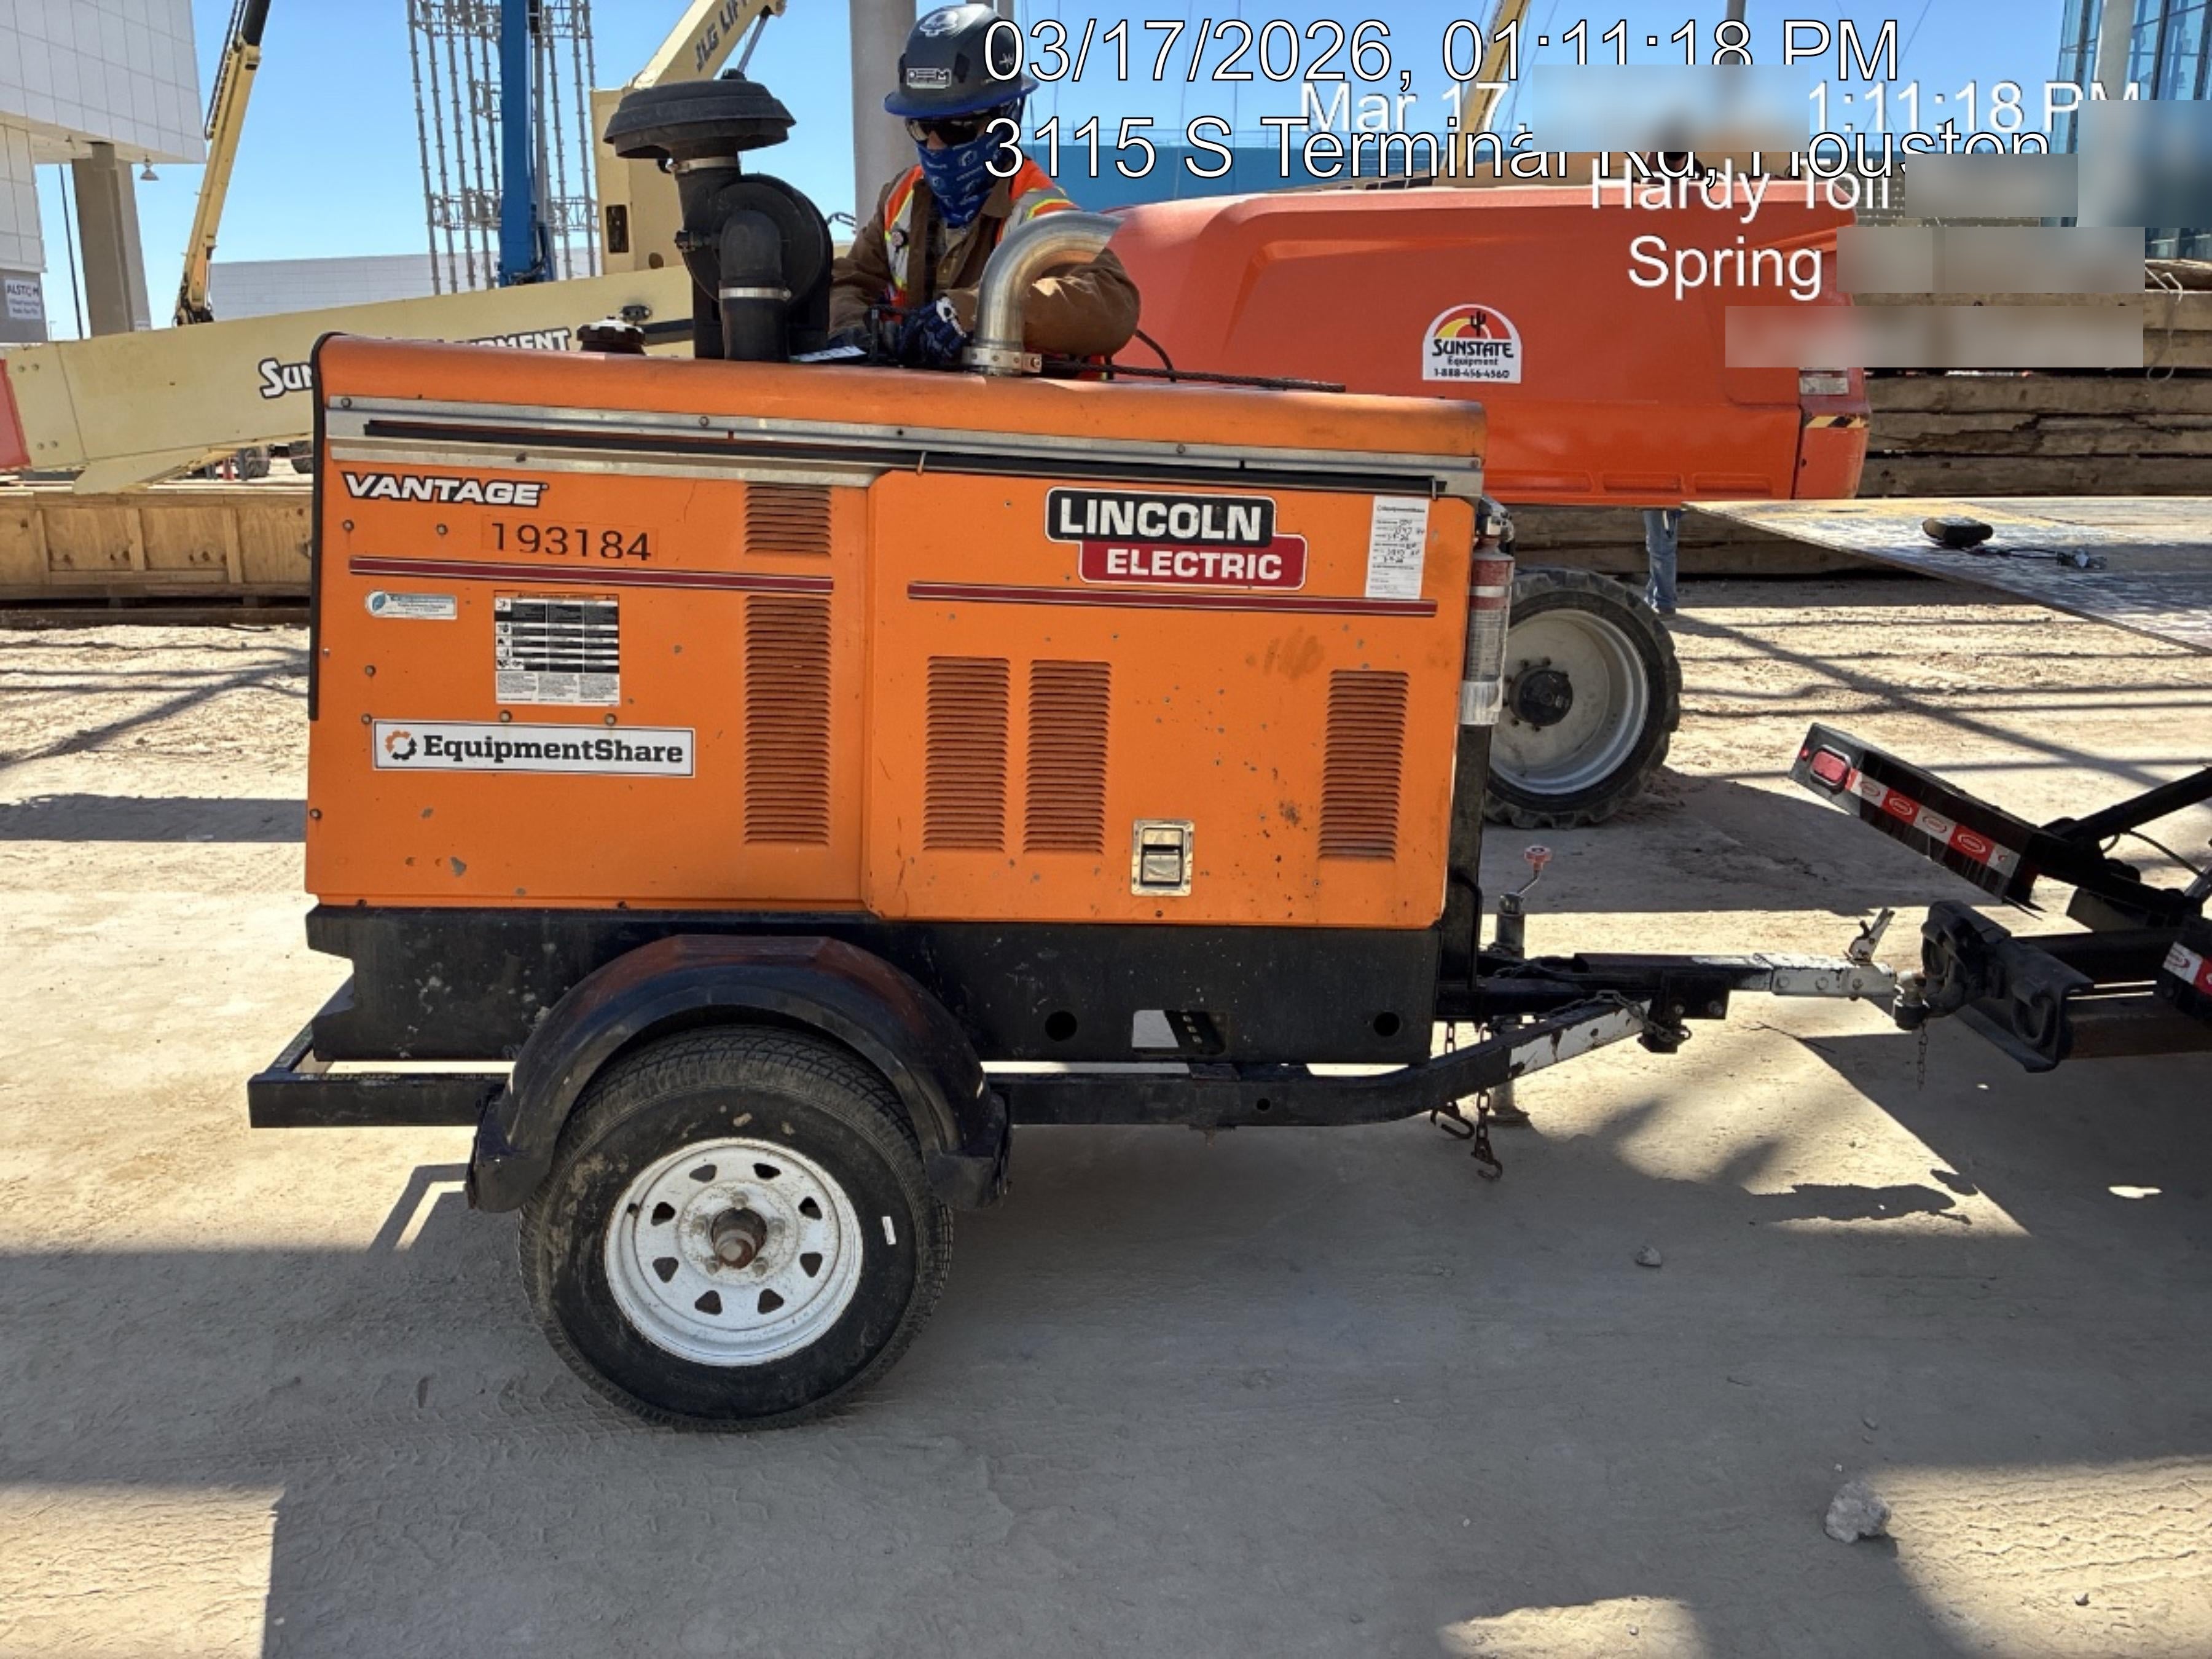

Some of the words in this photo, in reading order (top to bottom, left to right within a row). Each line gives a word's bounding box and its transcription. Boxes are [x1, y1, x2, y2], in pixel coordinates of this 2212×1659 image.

[1432, 339, 1514, 359] SUNSTATE
[1447, 356, 1499, 367] Equipment
[342, 471, 541, 508] VANTAGE
[1059, 497, 1262, 541] LINCOLN
[492, 522, 652, 562] 193184
[1107, 548, 1283, 581] ELECTRIC
[423, 734, 683, 764] EquipmentShare
